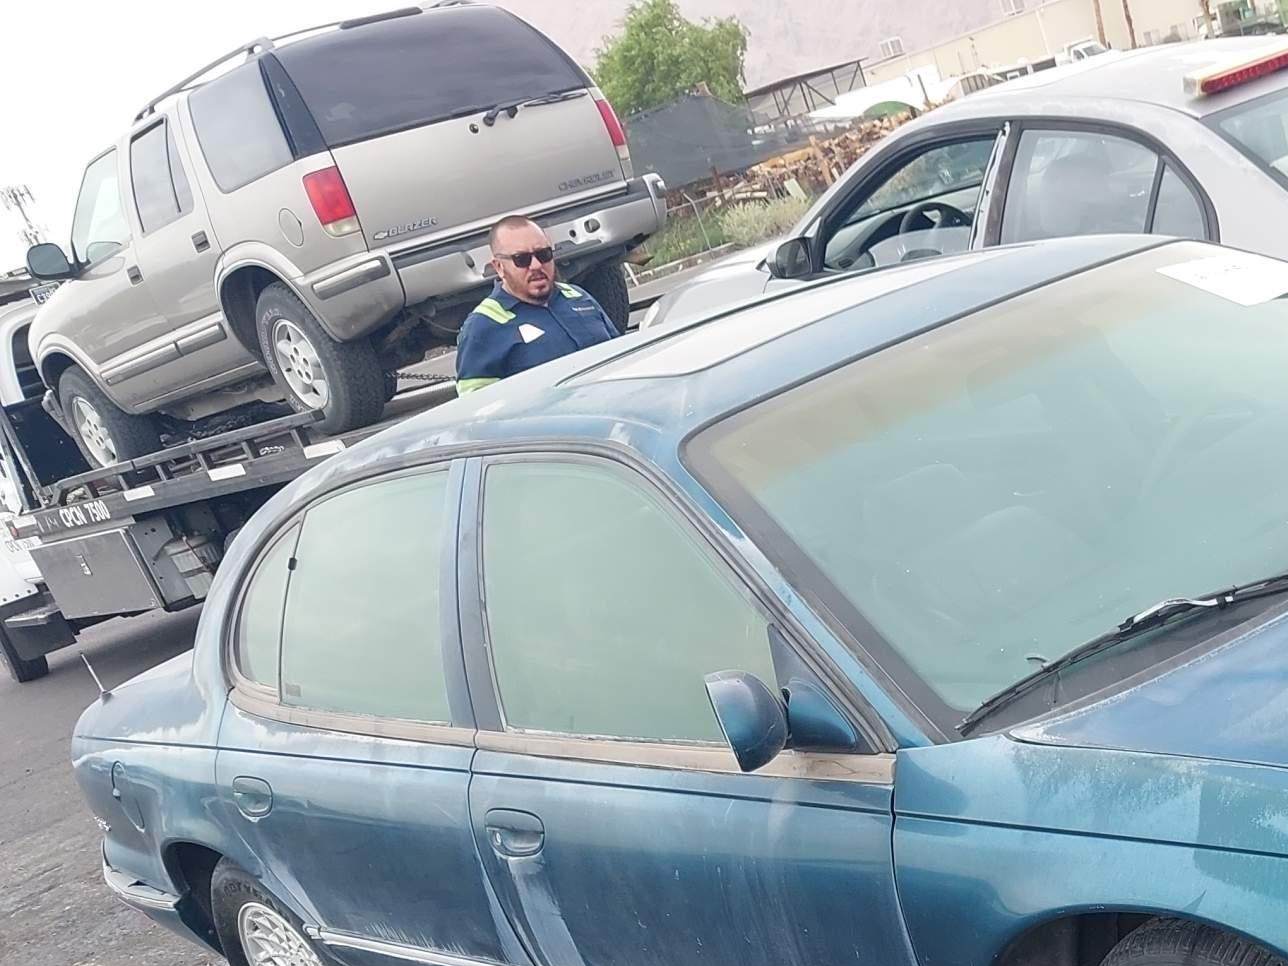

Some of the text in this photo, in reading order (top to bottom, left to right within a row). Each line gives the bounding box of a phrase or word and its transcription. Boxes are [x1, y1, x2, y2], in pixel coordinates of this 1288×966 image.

[388, 216, 439, 237] BLAZER
[59, 507, 88, 528] CPCN
[84, 499, 111, 522] 7500
